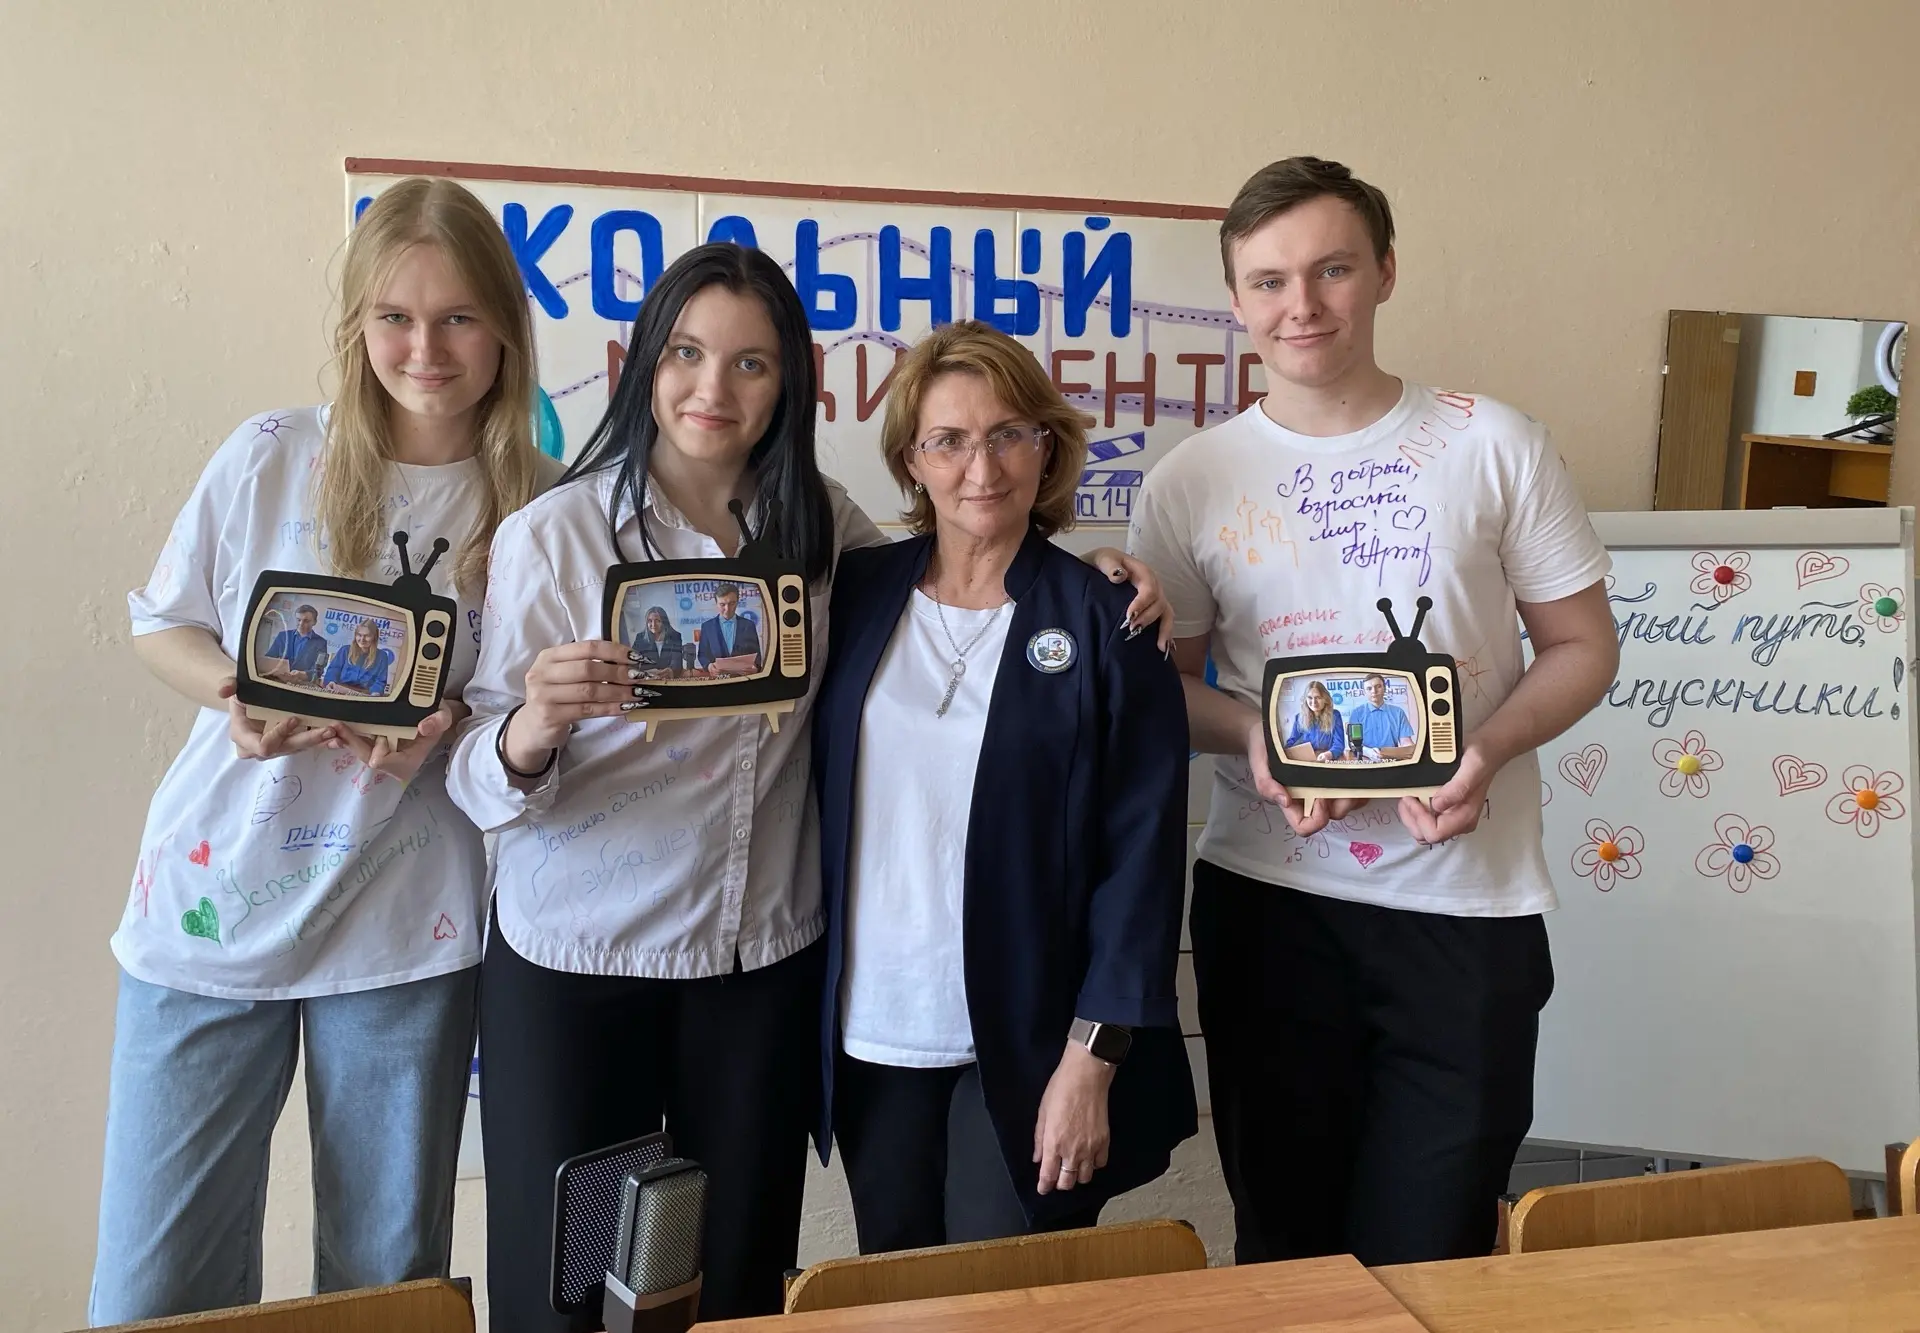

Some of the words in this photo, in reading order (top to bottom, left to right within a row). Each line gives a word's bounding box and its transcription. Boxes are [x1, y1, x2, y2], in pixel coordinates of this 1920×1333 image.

[355, 196, 1131, 338] КОЬНЫЙ
[1102, 488, 1131, 517] 14
[1277, 463, 1314, 498] В
[1731, 600, 1865, 667] путь,
